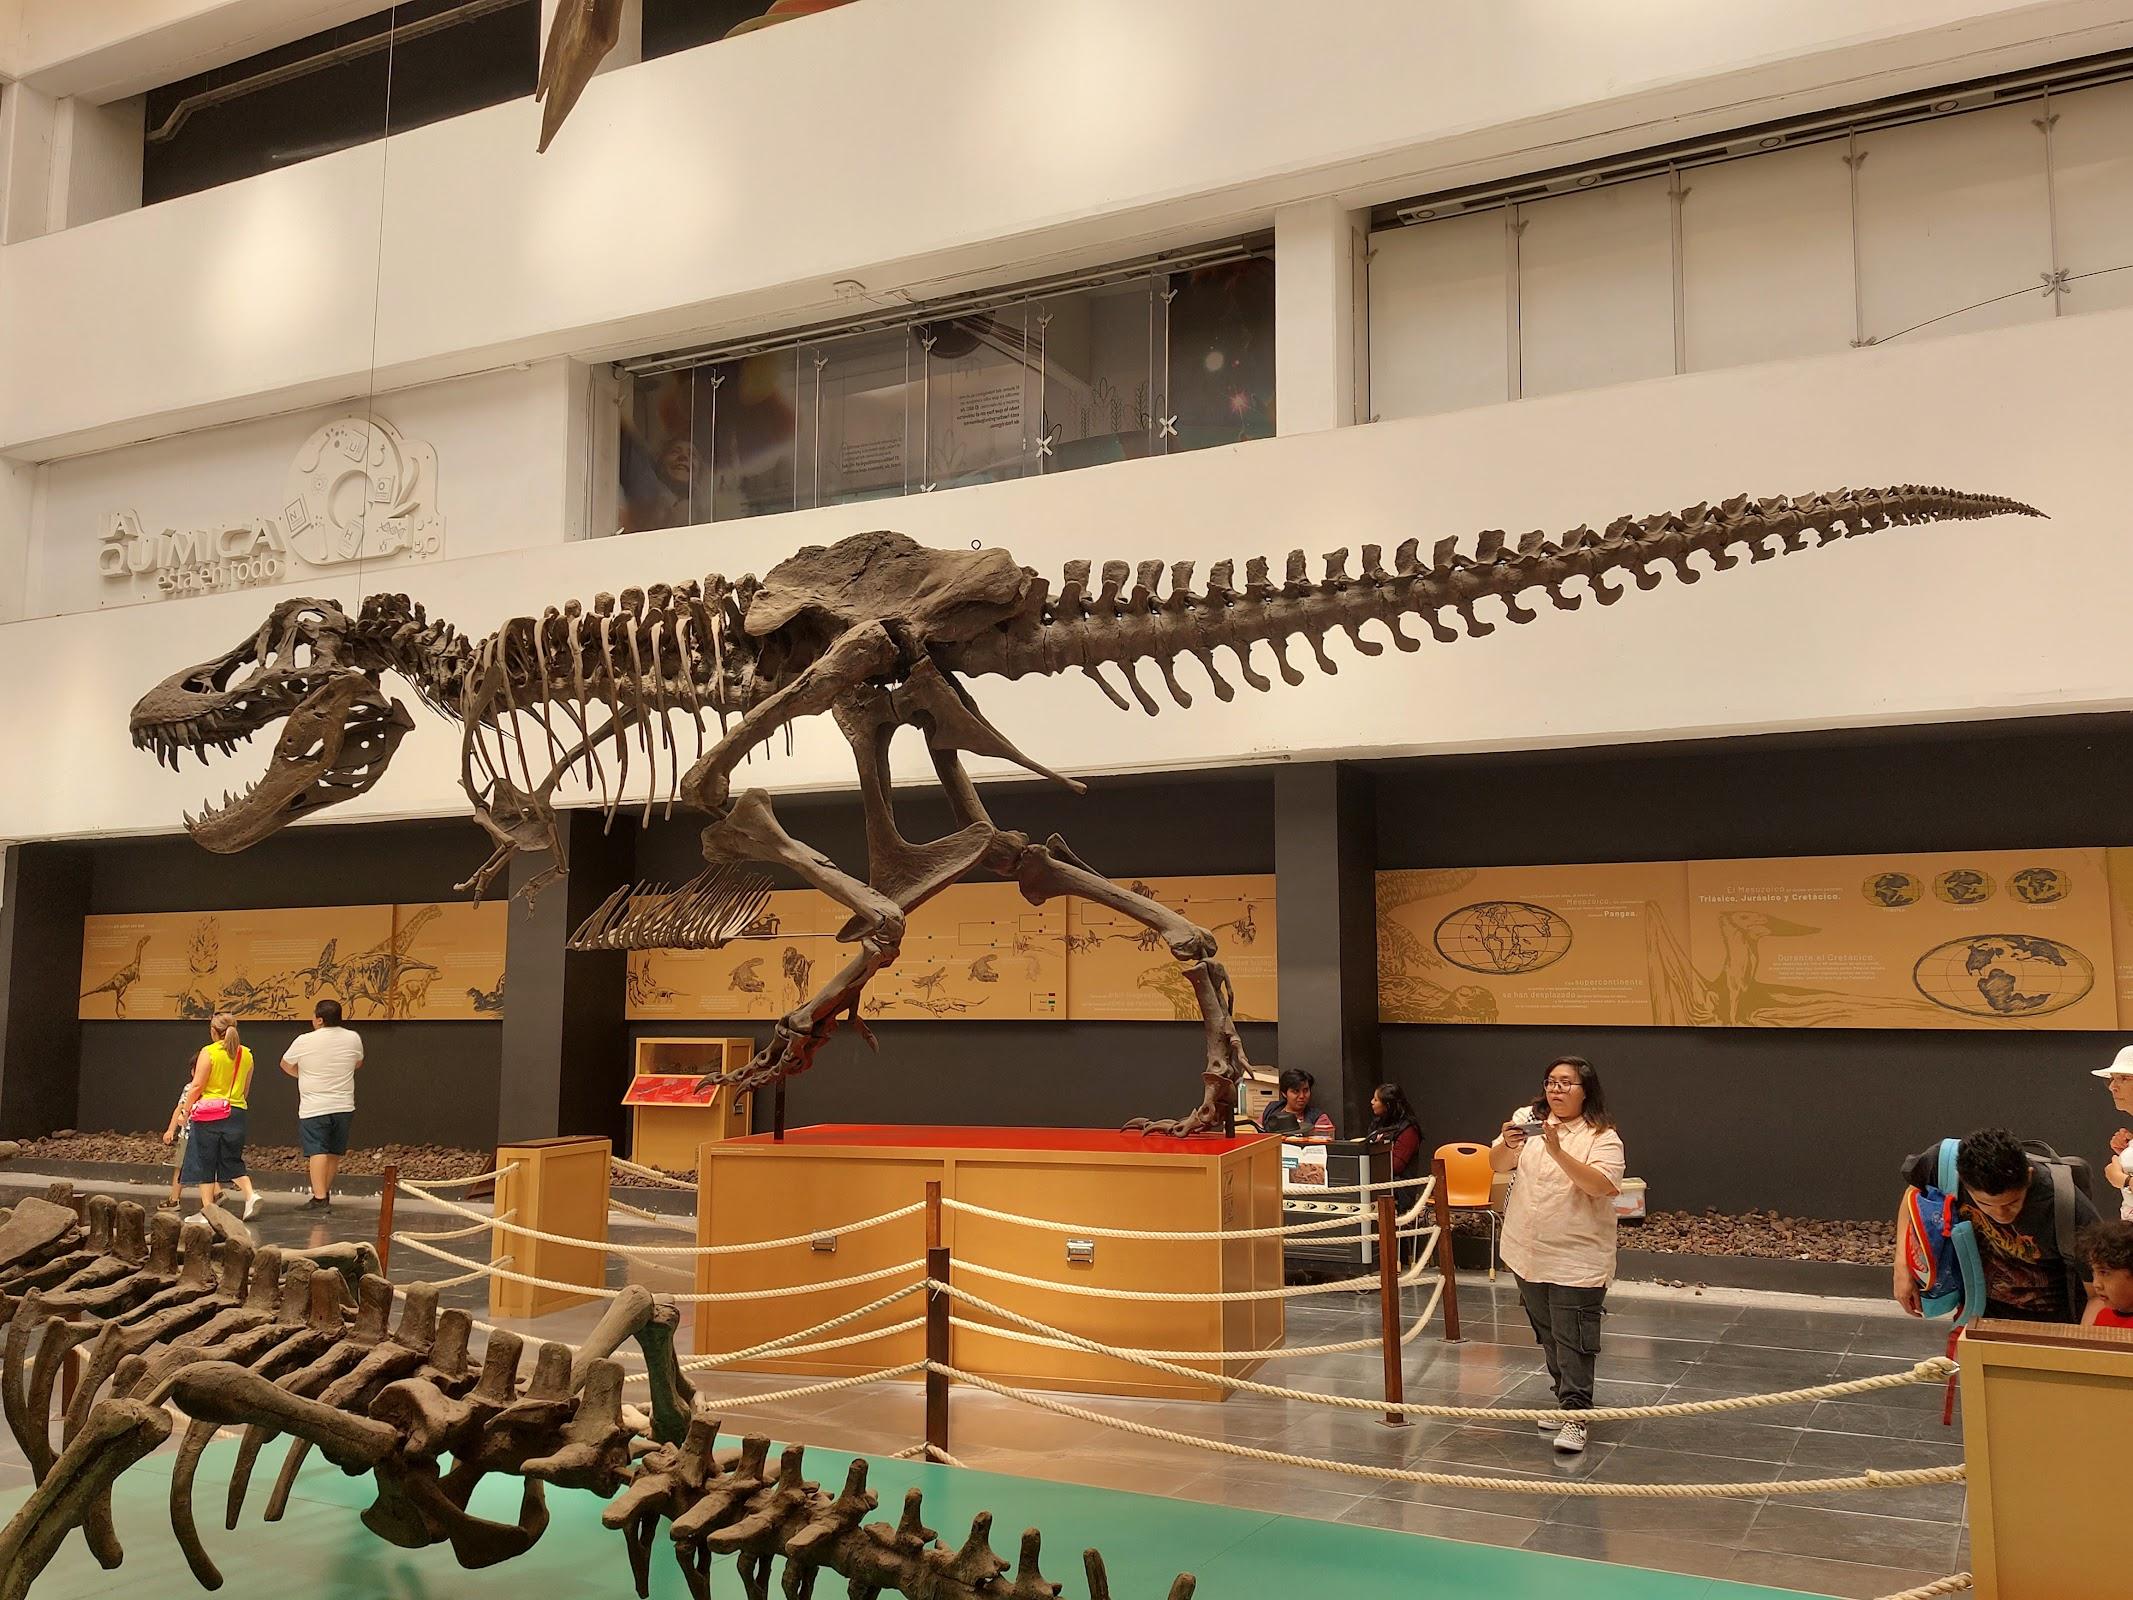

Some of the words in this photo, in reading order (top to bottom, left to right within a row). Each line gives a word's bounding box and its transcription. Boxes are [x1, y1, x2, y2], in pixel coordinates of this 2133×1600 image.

[98, 520, 287, 577] QUÍMICA
[200, 565, 225, 586] en
[229, 552, 279, 581] todo
